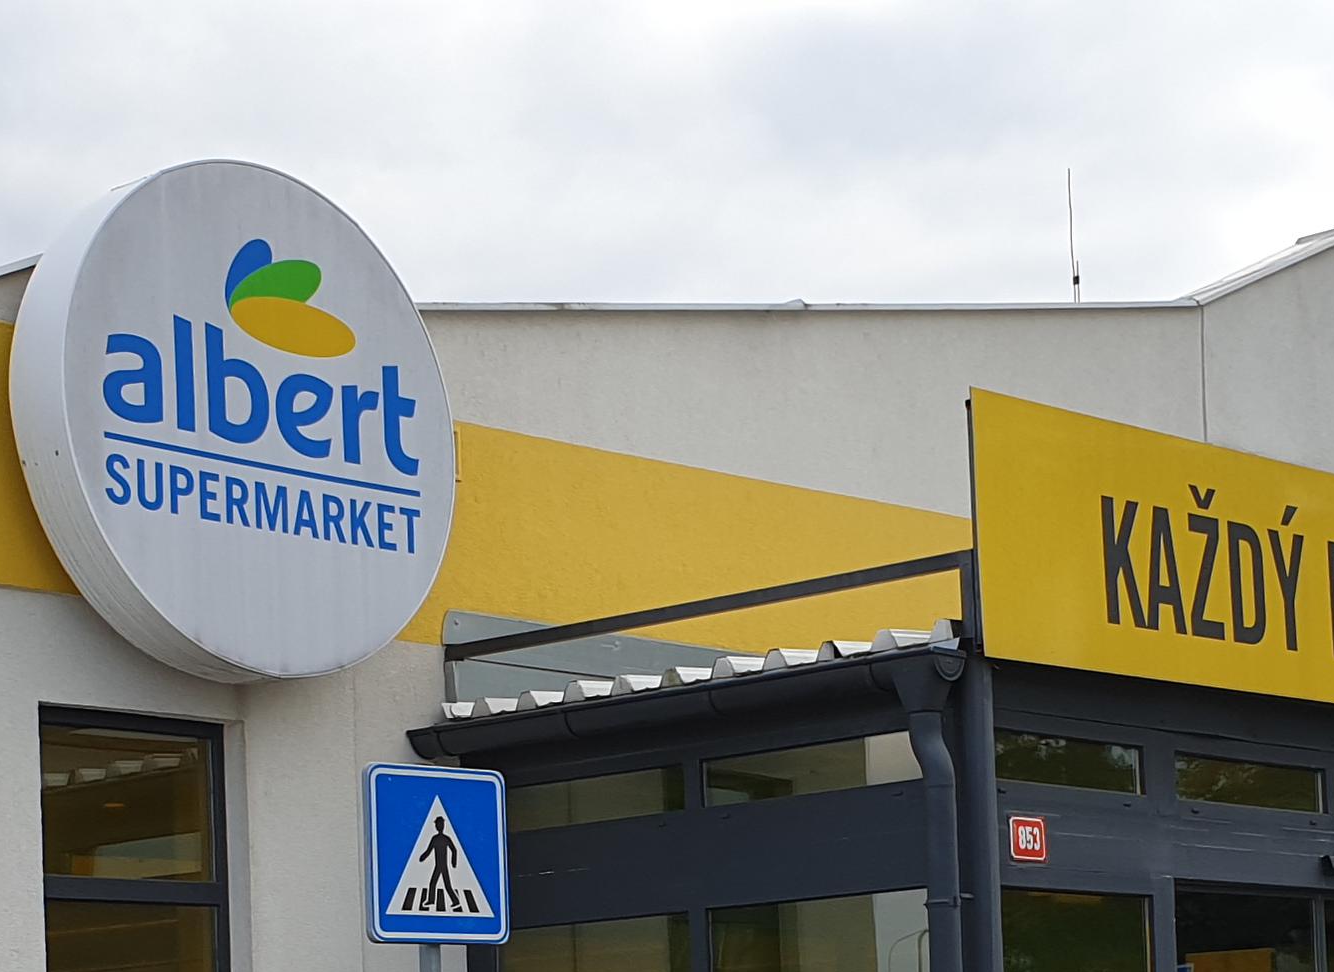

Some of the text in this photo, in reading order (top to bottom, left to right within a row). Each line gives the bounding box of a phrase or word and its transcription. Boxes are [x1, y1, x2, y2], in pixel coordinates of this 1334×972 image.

[102, 313, 420, 476] albert
[104, 453, 422, 555] SUPERMARKET
[1100, 484, 1304, 652] KAŽDÝ
[1018, 826, 1040, 851] 853
